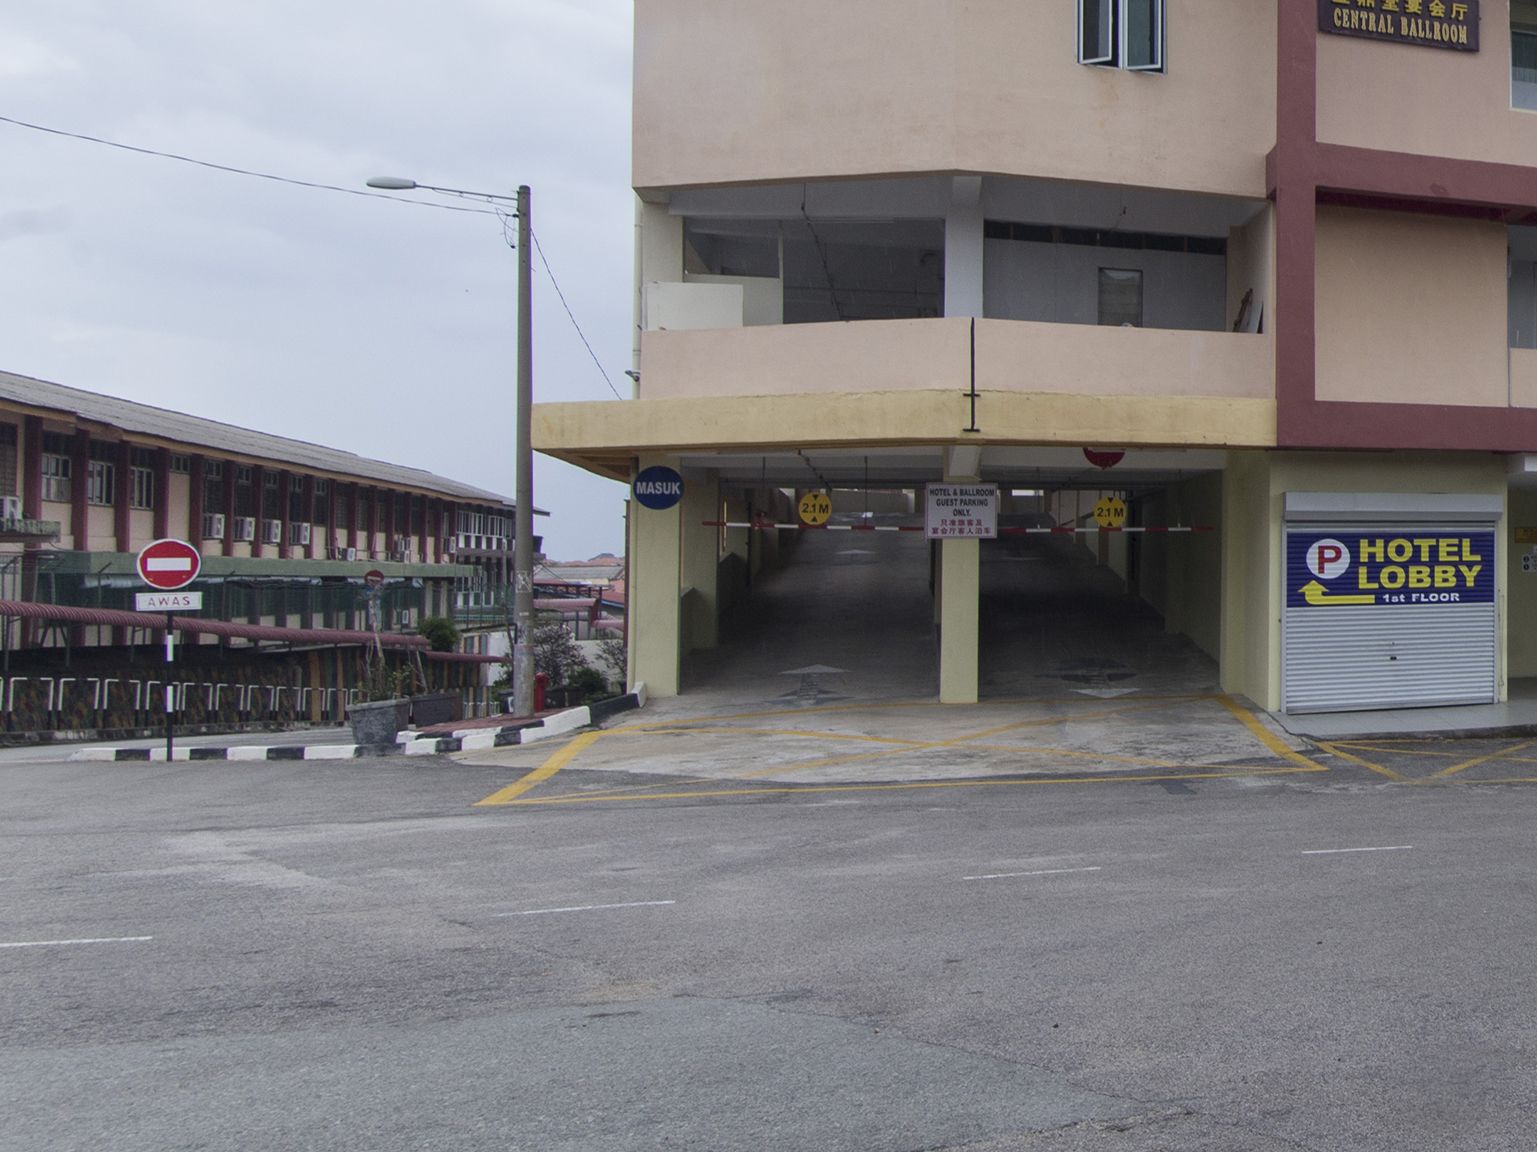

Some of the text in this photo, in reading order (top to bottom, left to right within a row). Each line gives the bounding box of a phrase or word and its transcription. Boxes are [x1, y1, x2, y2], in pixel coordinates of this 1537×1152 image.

[1333, 7, 1467, 44] CENTRAL BALLROOM
[636, 481, 680, 494] MASUK
[929, 488, 951, 496] HOTEL
[959, 488, 994, 496] BALLROOM
[936, 498, 988, 506] GUEST PARKING
[802, 503, 829, 514] 2.1 M
[953, 508, 972, 516] ONLY.
[1097, 507, 1124, 517] 2.1 M
[1358, 538, 1482, 563] HOTEL
[1317, 545, 1342, 574] P
[1358, 564, 1482, 590] LOBBY
[148, 596, 190, 607] AWAS
[1382, 592, 1460, 603] 1st FLOOR
